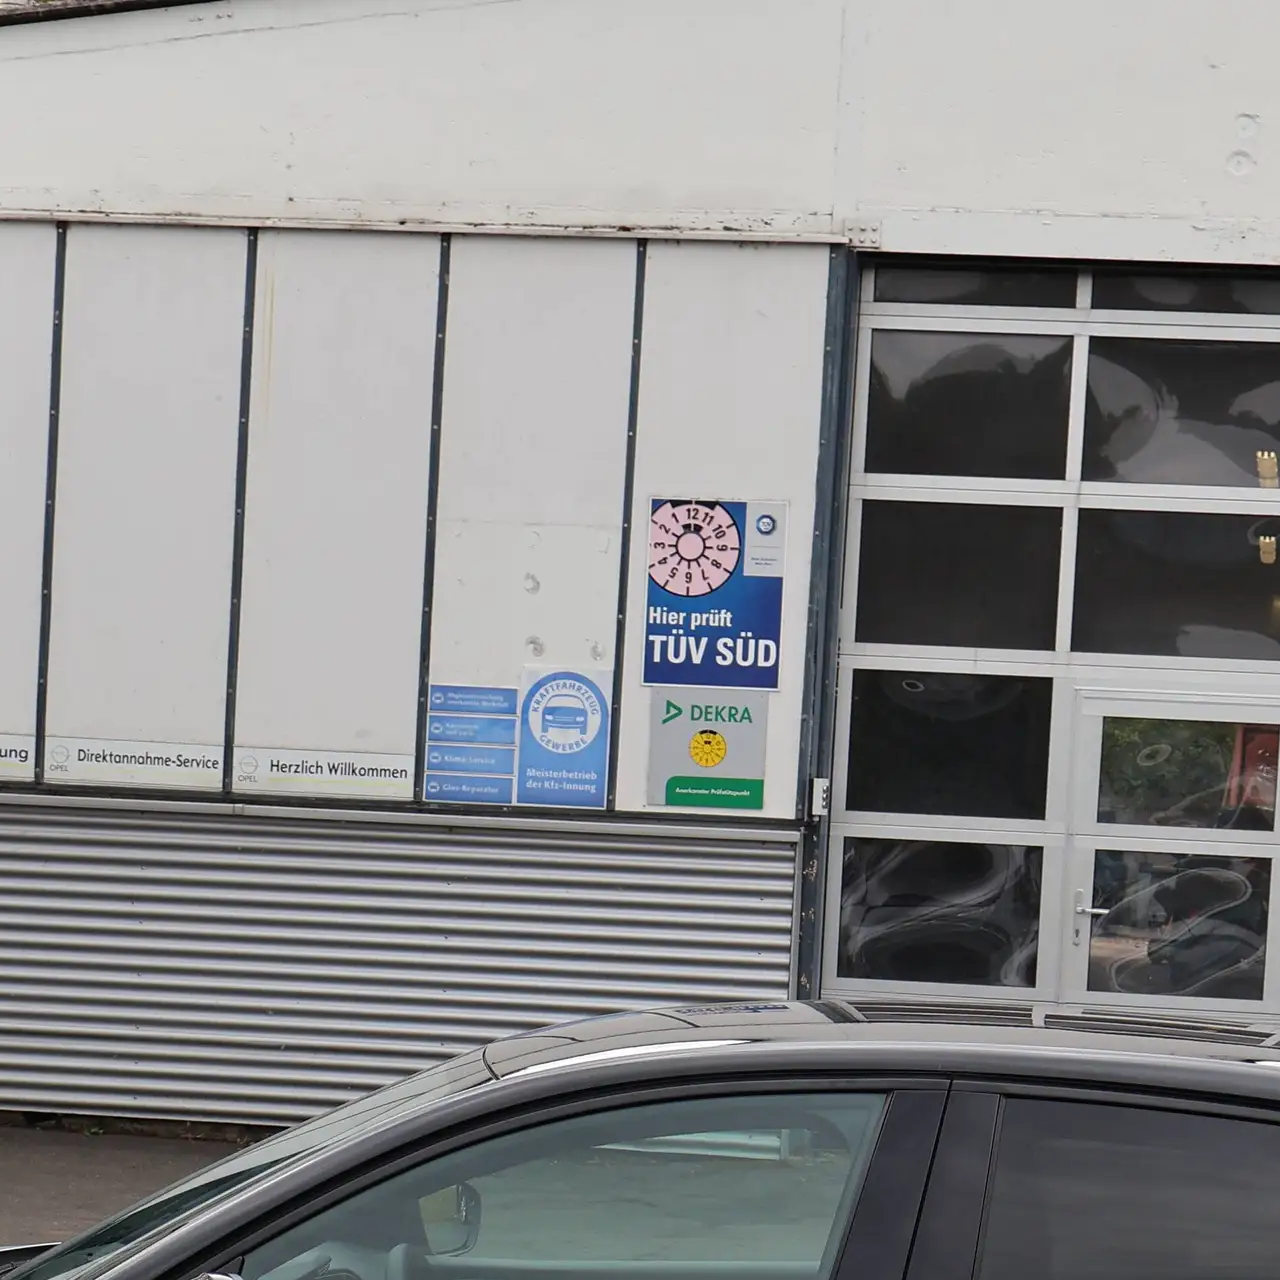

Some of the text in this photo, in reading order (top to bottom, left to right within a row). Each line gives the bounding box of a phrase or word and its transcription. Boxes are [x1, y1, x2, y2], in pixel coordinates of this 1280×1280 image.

[671, 512, 680, 524] 1
[685, 508, 699, 520] 12
[701, 512, 715, 526] 11
[659, 524, 671, 535] 2
[712, 524, 726, 539] 10
[654, 541, 666, 550] 3
[658, 556, 668, 565] 4
[711, 559, 722, 569] 8
[668, 566, 679, 579] 5
[649, 606, 732, 630] Hier prüft
[648, 628, 777, 667] TÜV SÜD
[532, 681, 599, 715] KRAFTFAHRZEUG
[690, 704, 753, 723] DEKRA
[539, 734, 587, 751] GEWERBE
[77, 749, 220, 770] Direktannahme-Service
[49, 764, 69, 772] OPEL
[270, 759, 408, 779] Herzlich Willkommen
[526, 767, 597, 780] Meisterbetrieb
[238, 774, 258, 783] OPEL
[525, 779, 597, 793] der Kfz-Innung
